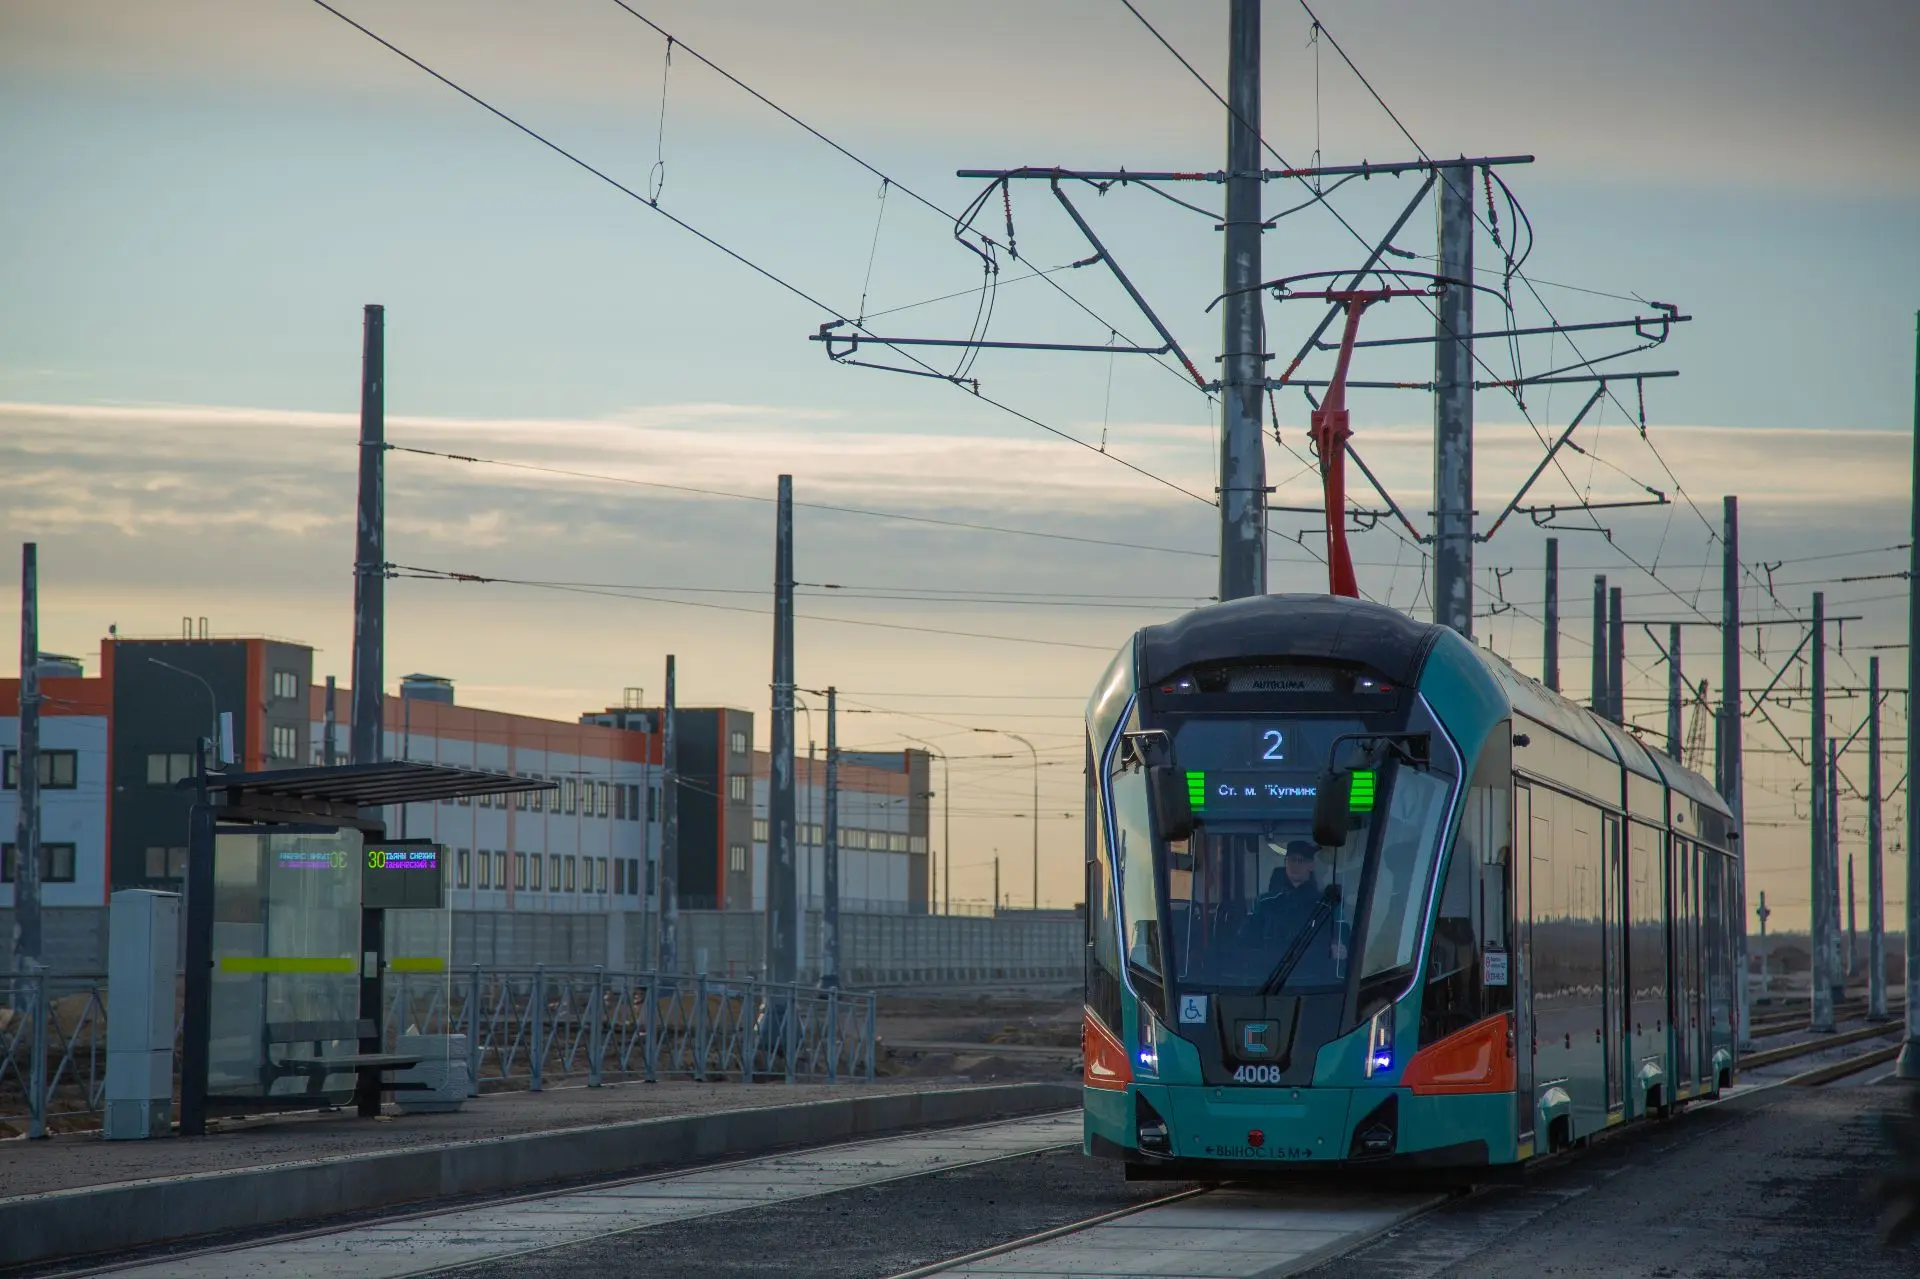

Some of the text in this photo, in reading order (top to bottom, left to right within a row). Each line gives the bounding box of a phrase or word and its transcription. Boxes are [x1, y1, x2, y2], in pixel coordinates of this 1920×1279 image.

[1263, 730, 1283, 760] 2
[1219, 784, 1237, 796] Ст.
[1245, 787, 1256, 796] м.
[368, 851, 386, 869] 30
[1233, 1065, 1281, 1083] 4008
[1216, 1146, 1267, 1158] ВЫНОС
